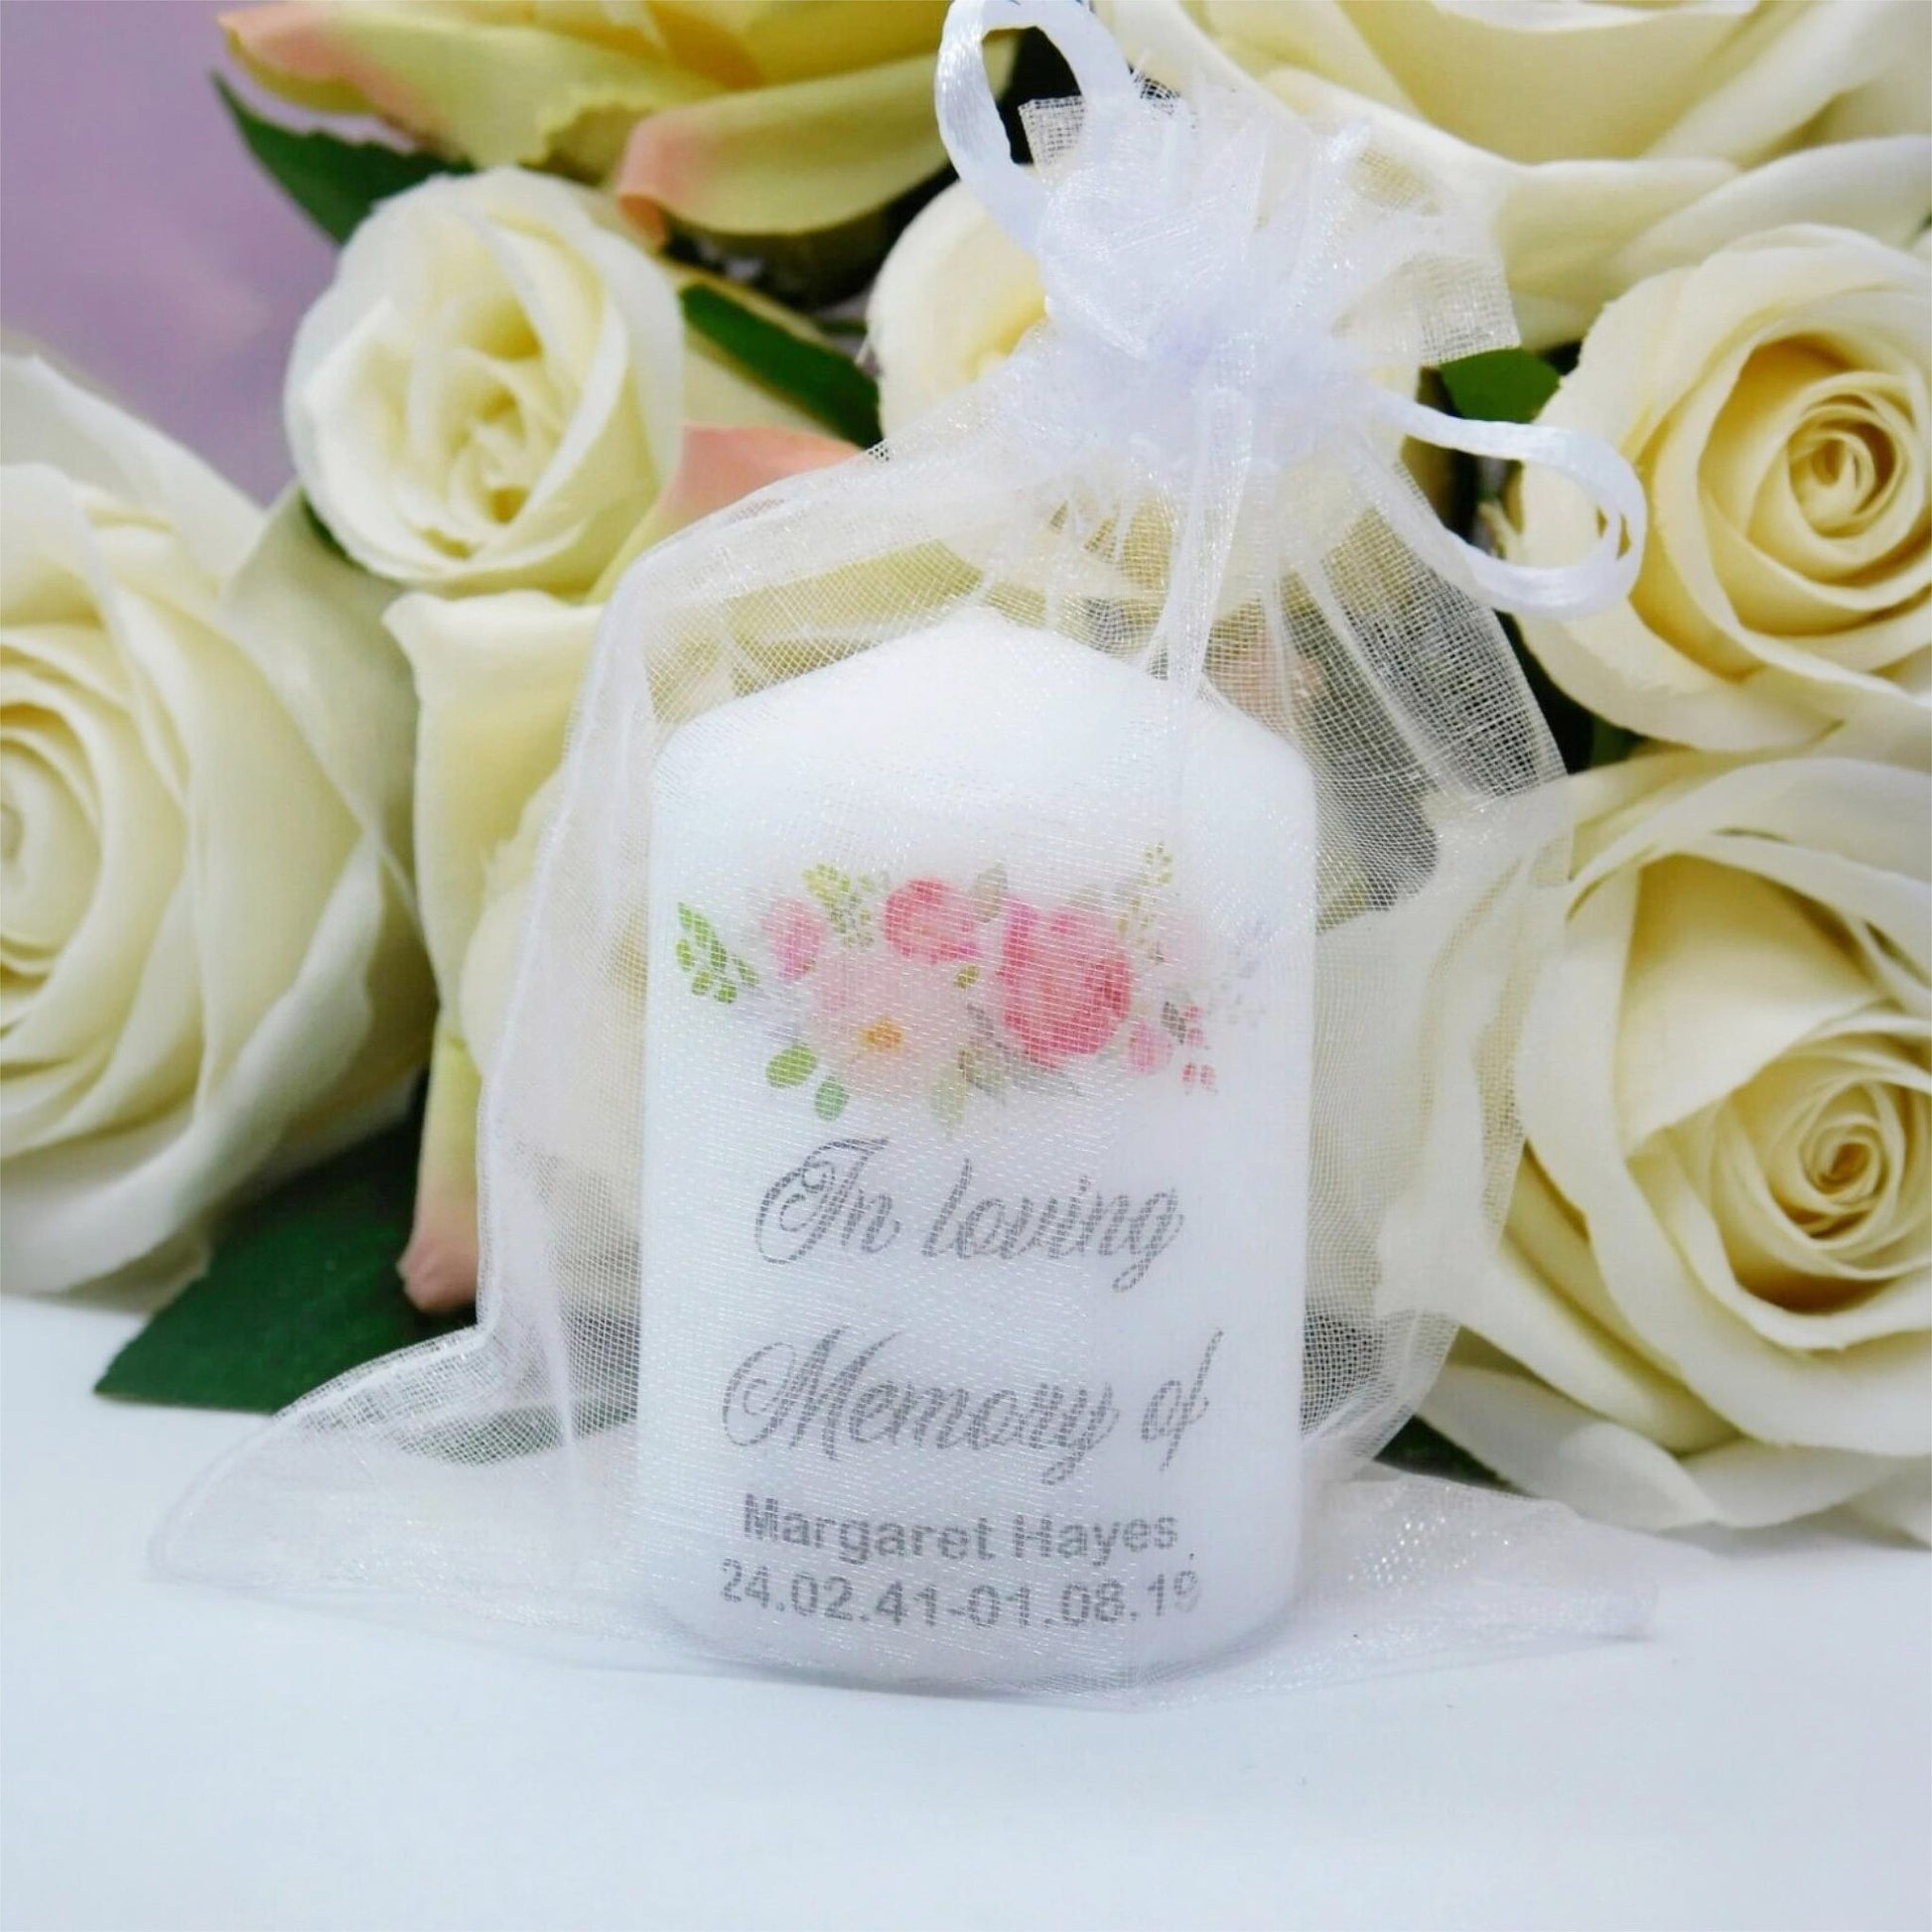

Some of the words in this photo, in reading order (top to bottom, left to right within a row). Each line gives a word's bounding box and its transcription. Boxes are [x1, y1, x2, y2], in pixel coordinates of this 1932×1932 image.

[755, 1138, 901, 1266] In
[921, 1158, 1185, 1293] loving
[722, 1325, 1121, 1486] Memory
[1140, 1326, 1224, 1472] of
[743, 1492, 996, 1565] Margaret
[1014, 1513, 1178, 1567] Hayes
[719, 1557, 1199, 1627] 24.02.41-01.08.19
